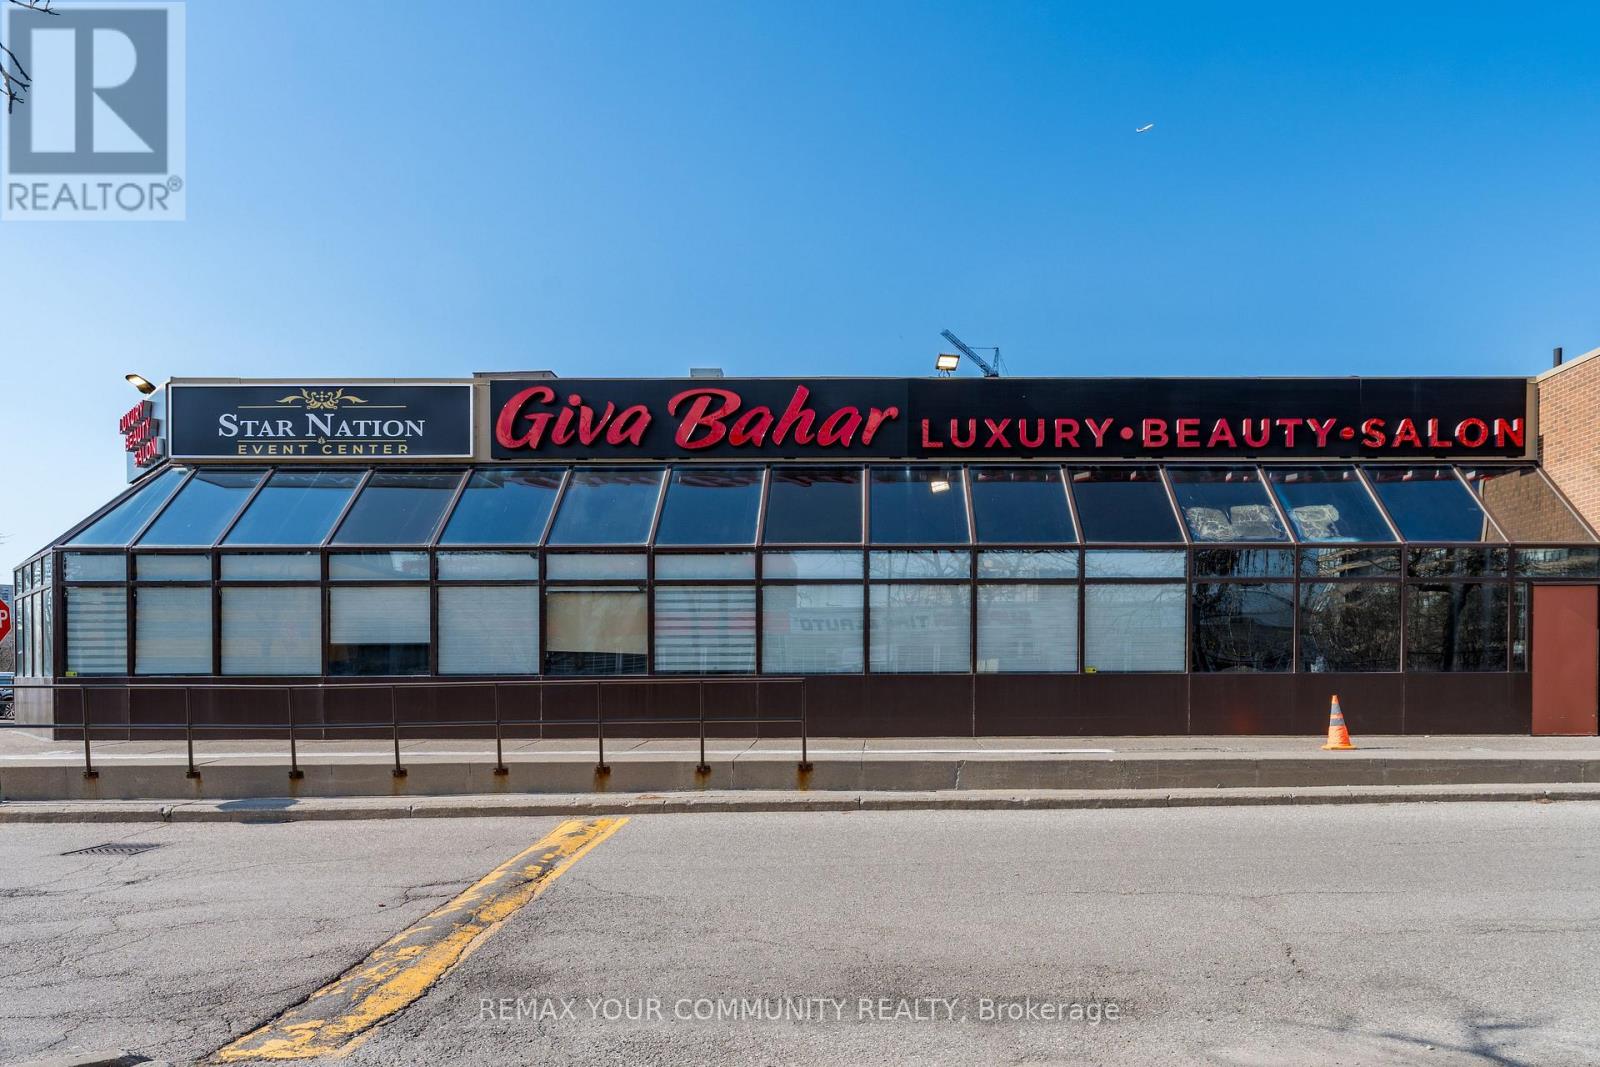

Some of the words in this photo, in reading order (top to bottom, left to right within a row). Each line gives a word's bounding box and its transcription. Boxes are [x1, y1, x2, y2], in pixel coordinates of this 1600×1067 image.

[120, 400, 145, 434] LUXURY
[218, 413, 296, 437] STAR
[305, 413, 425, 437] NATION
[495, 385, 653, 450] Giva
[668, 385, 899, 450] Bahar
[921, 418, 1114, 448] LUXURY
[1142, 418, 1337, 448] BEAUTY
[1361, 417, 1525, 448] SALON
[126, 417, 152, 451] BEAUTY
[237, 444, 309, 455] EVENT
[321, 444, 409, 455] CENTER
[135, 436, 158, 467] SALON
